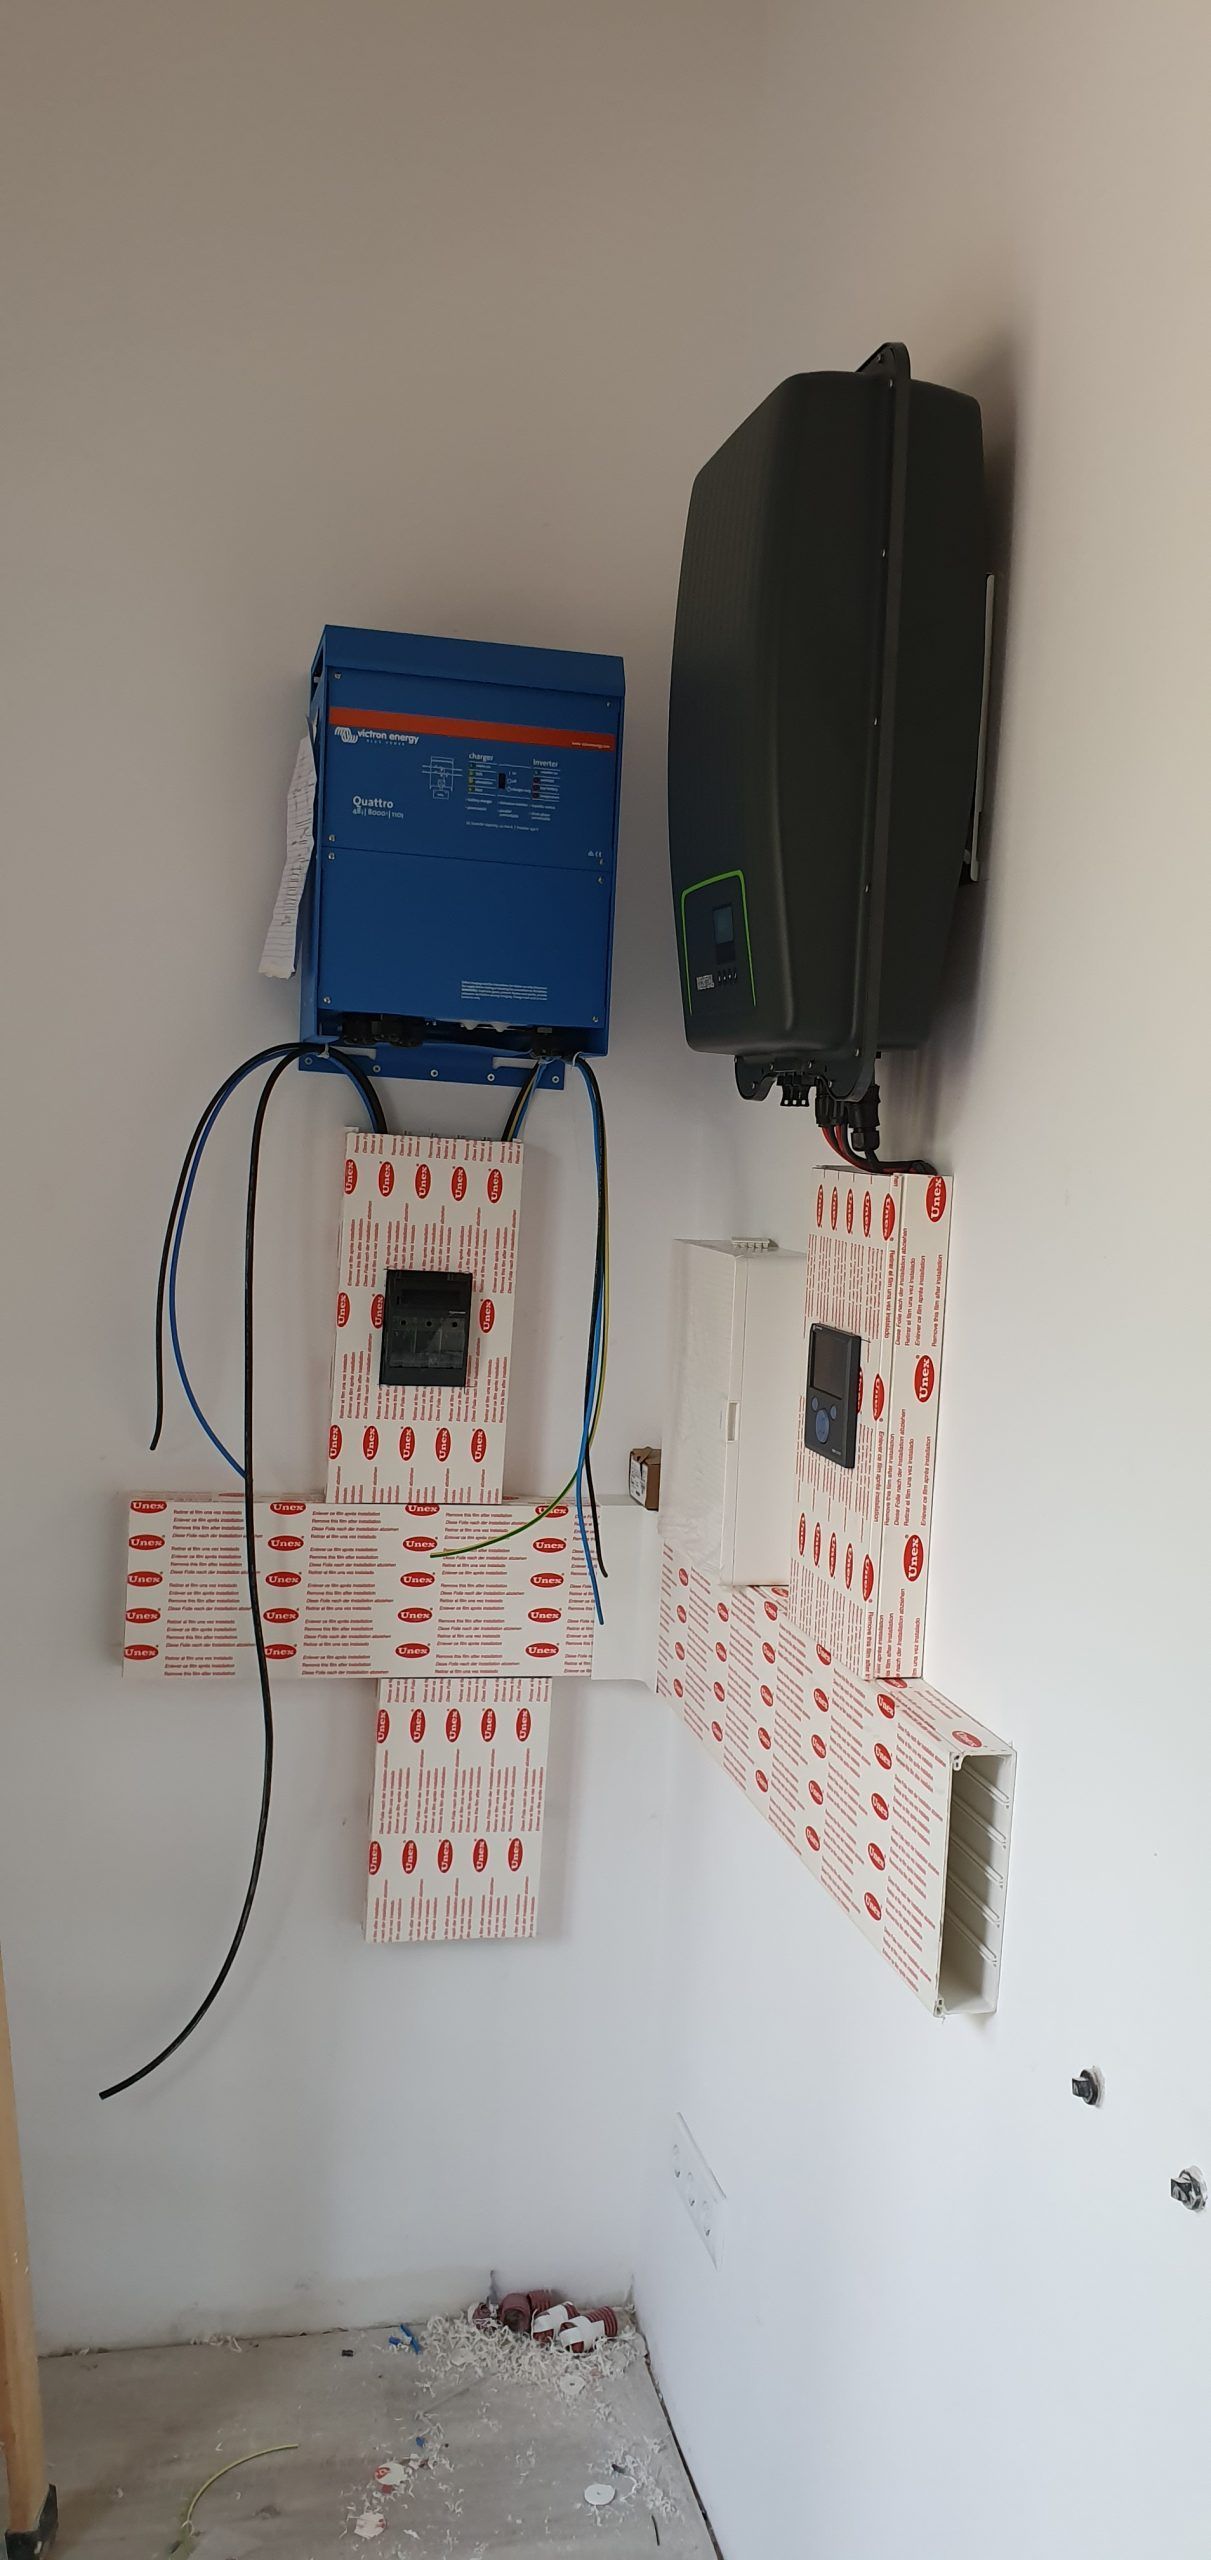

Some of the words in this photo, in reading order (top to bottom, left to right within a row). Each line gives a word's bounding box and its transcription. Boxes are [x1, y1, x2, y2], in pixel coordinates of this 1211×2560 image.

[358, 729, 387, 740] victron
[389, 732, 420, 745] energy
[469, 752, 494, 761] charger
[352, 796, 394, 809] Quattro
[345, 1162, 354, 1191] Unex
[382, 1164, 391, 1194] Unex
[419, 1167, 427, 1196] Unex
[455, 1169, 464, 1198] Unex
[491, 1172, 499, 1200] Unex
[930, 1178, 942, 1219] Unex
[338, 1295, 346, 1324] Unex
[483, 1302, 491, 1330] Unex
[919, 1358, 931, 1400] Unex
[329, 1428, 338, 1457] Unex
[367, 1428, 376, 1457] Unex
[402, 1429, 412, 1458] Unex
[438, 1430, 448, 1459] Unex
[474, 1431, 483, 1460] Unex
[273, 1503, 304, 1511] Unex
[408, 1504, 438, 1512] Unex
[406, 1540, 436, 1548] Unex
[908, 1538, 920, 1578] Unex
[129, 1575, 160, 1583] Unex
[127, 1612, 158, 1620] Unex
[399, 1612, 430, 1620] Unex
[265, 1648, 294, 1656] Unex
[398, 1647, 427, 1655] Unex
[528, 1647, 557, 1655] Unex
[377, 1712, 386, 1741] Unex
[413, 1711, 422, 1740] Unex
[449, 1711, 458, 1740] Unex
[484, 1711, 493, 1739] Unex
[519, 1711, 528, 1739] Unex
[370, 1844, 378, 1872] Unex
[405, 1843, 414, 1871] Unex
[441, 1842, 449, 1871] Unex
[476, 1841, 485, 1870] Unex
[511, 1841, 519, 1869] Unex
